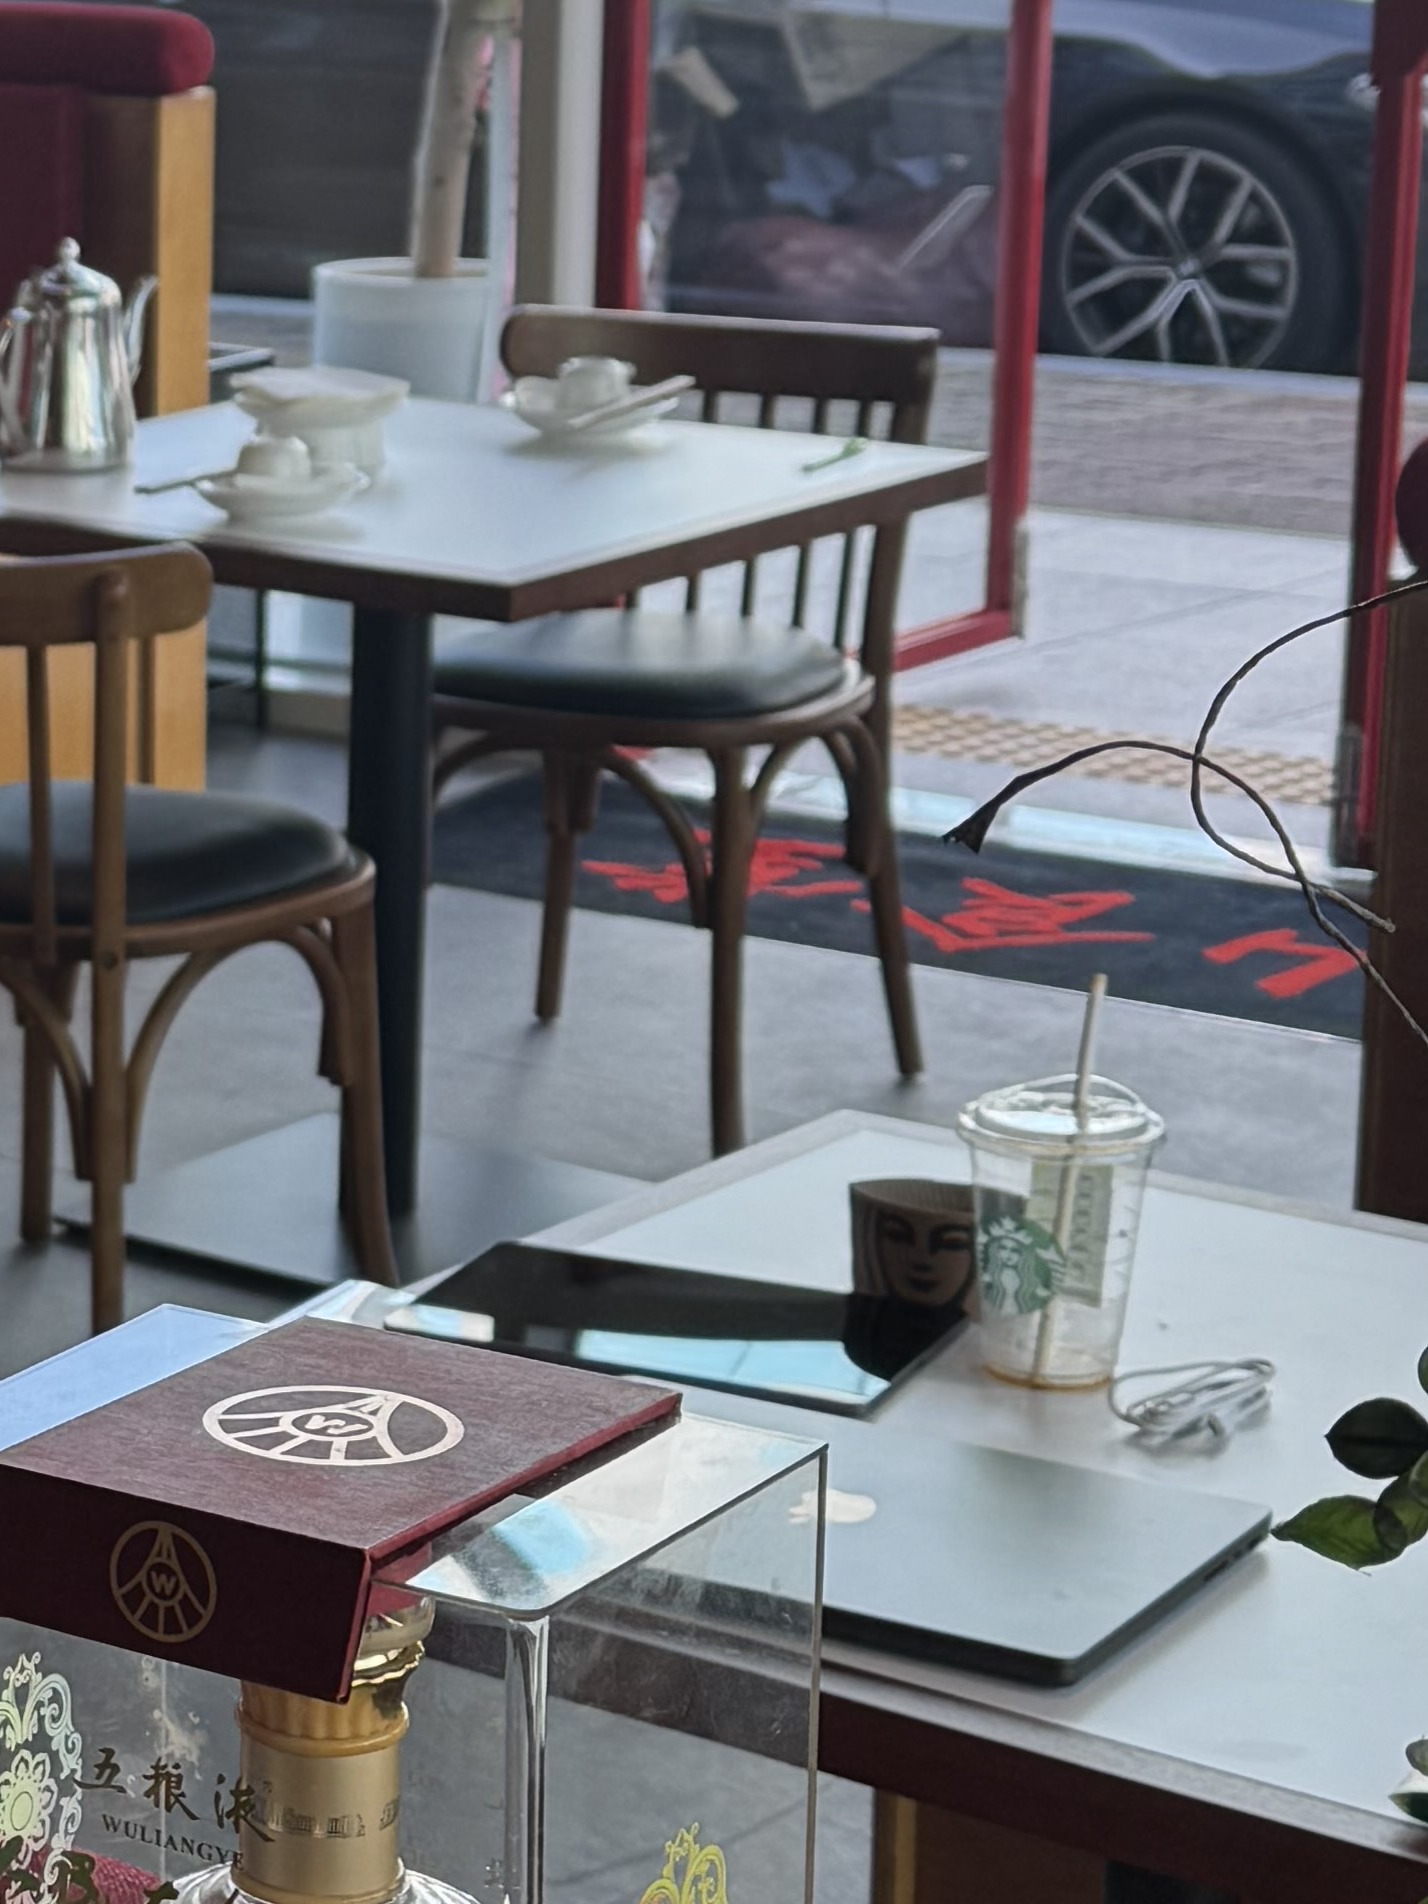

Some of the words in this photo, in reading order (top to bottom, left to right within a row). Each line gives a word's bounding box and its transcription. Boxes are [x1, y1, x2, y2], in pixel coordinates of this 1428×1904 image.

[73, 1746, 275, 1843] 五粮液
[101, 1812, 245, 1872] WULIANGYE
